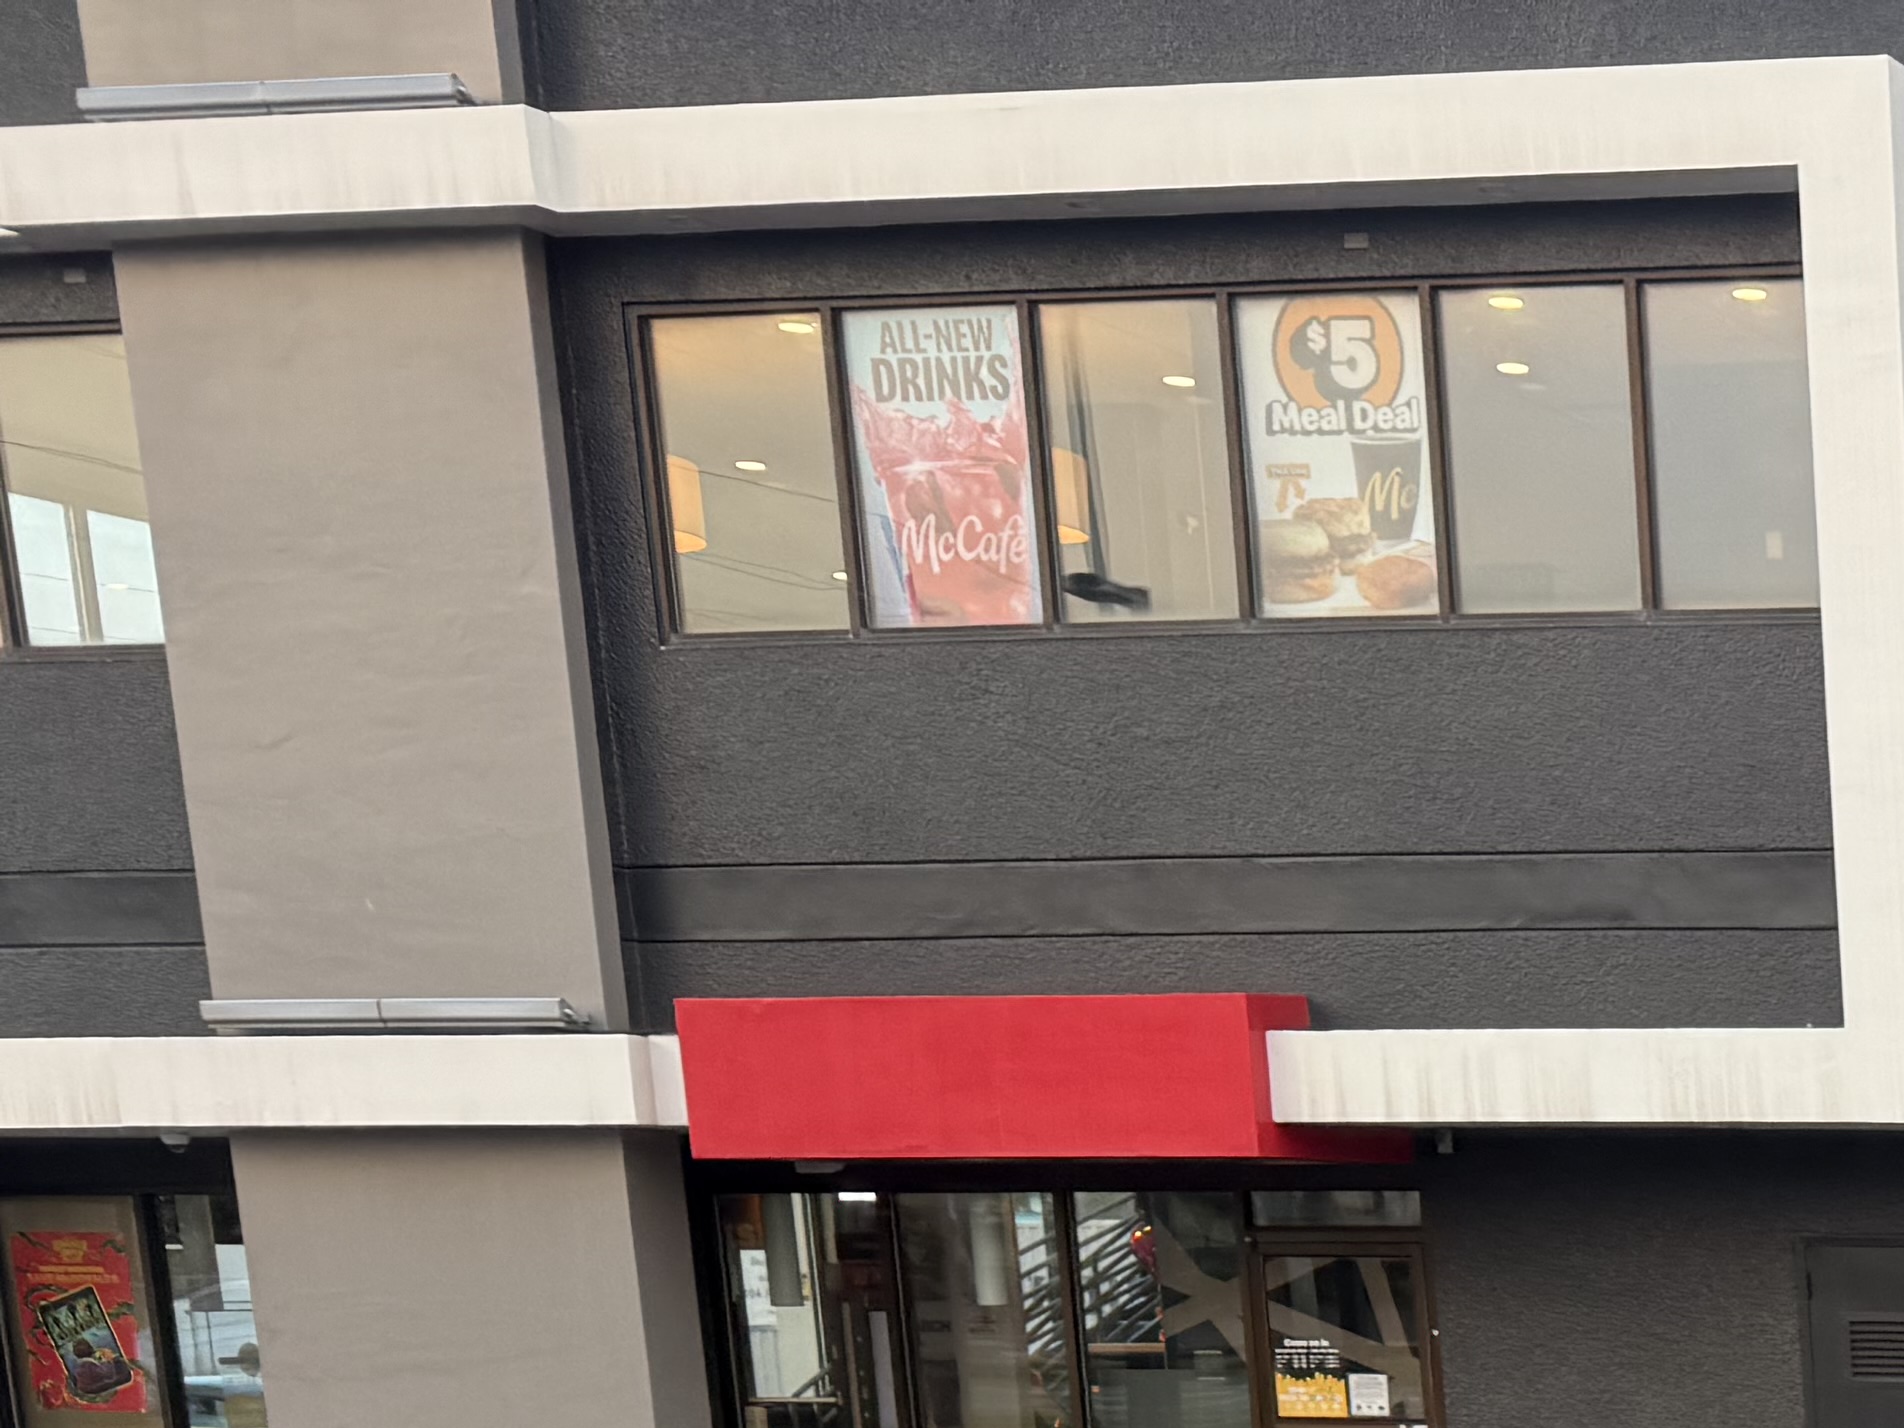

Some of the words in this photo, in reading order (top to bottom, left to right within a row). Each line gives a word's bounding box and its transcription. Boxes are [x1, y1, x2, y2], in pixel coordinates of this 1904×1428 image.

[880, 317, 993, 355] ALL-NEW
[1304, 317, 1379, 391] $5
[870, 353, 1011, 404] DRINKS
[1267, 399, 1347, 434] Meal
[1351, 396, 1421, 433] Deal
